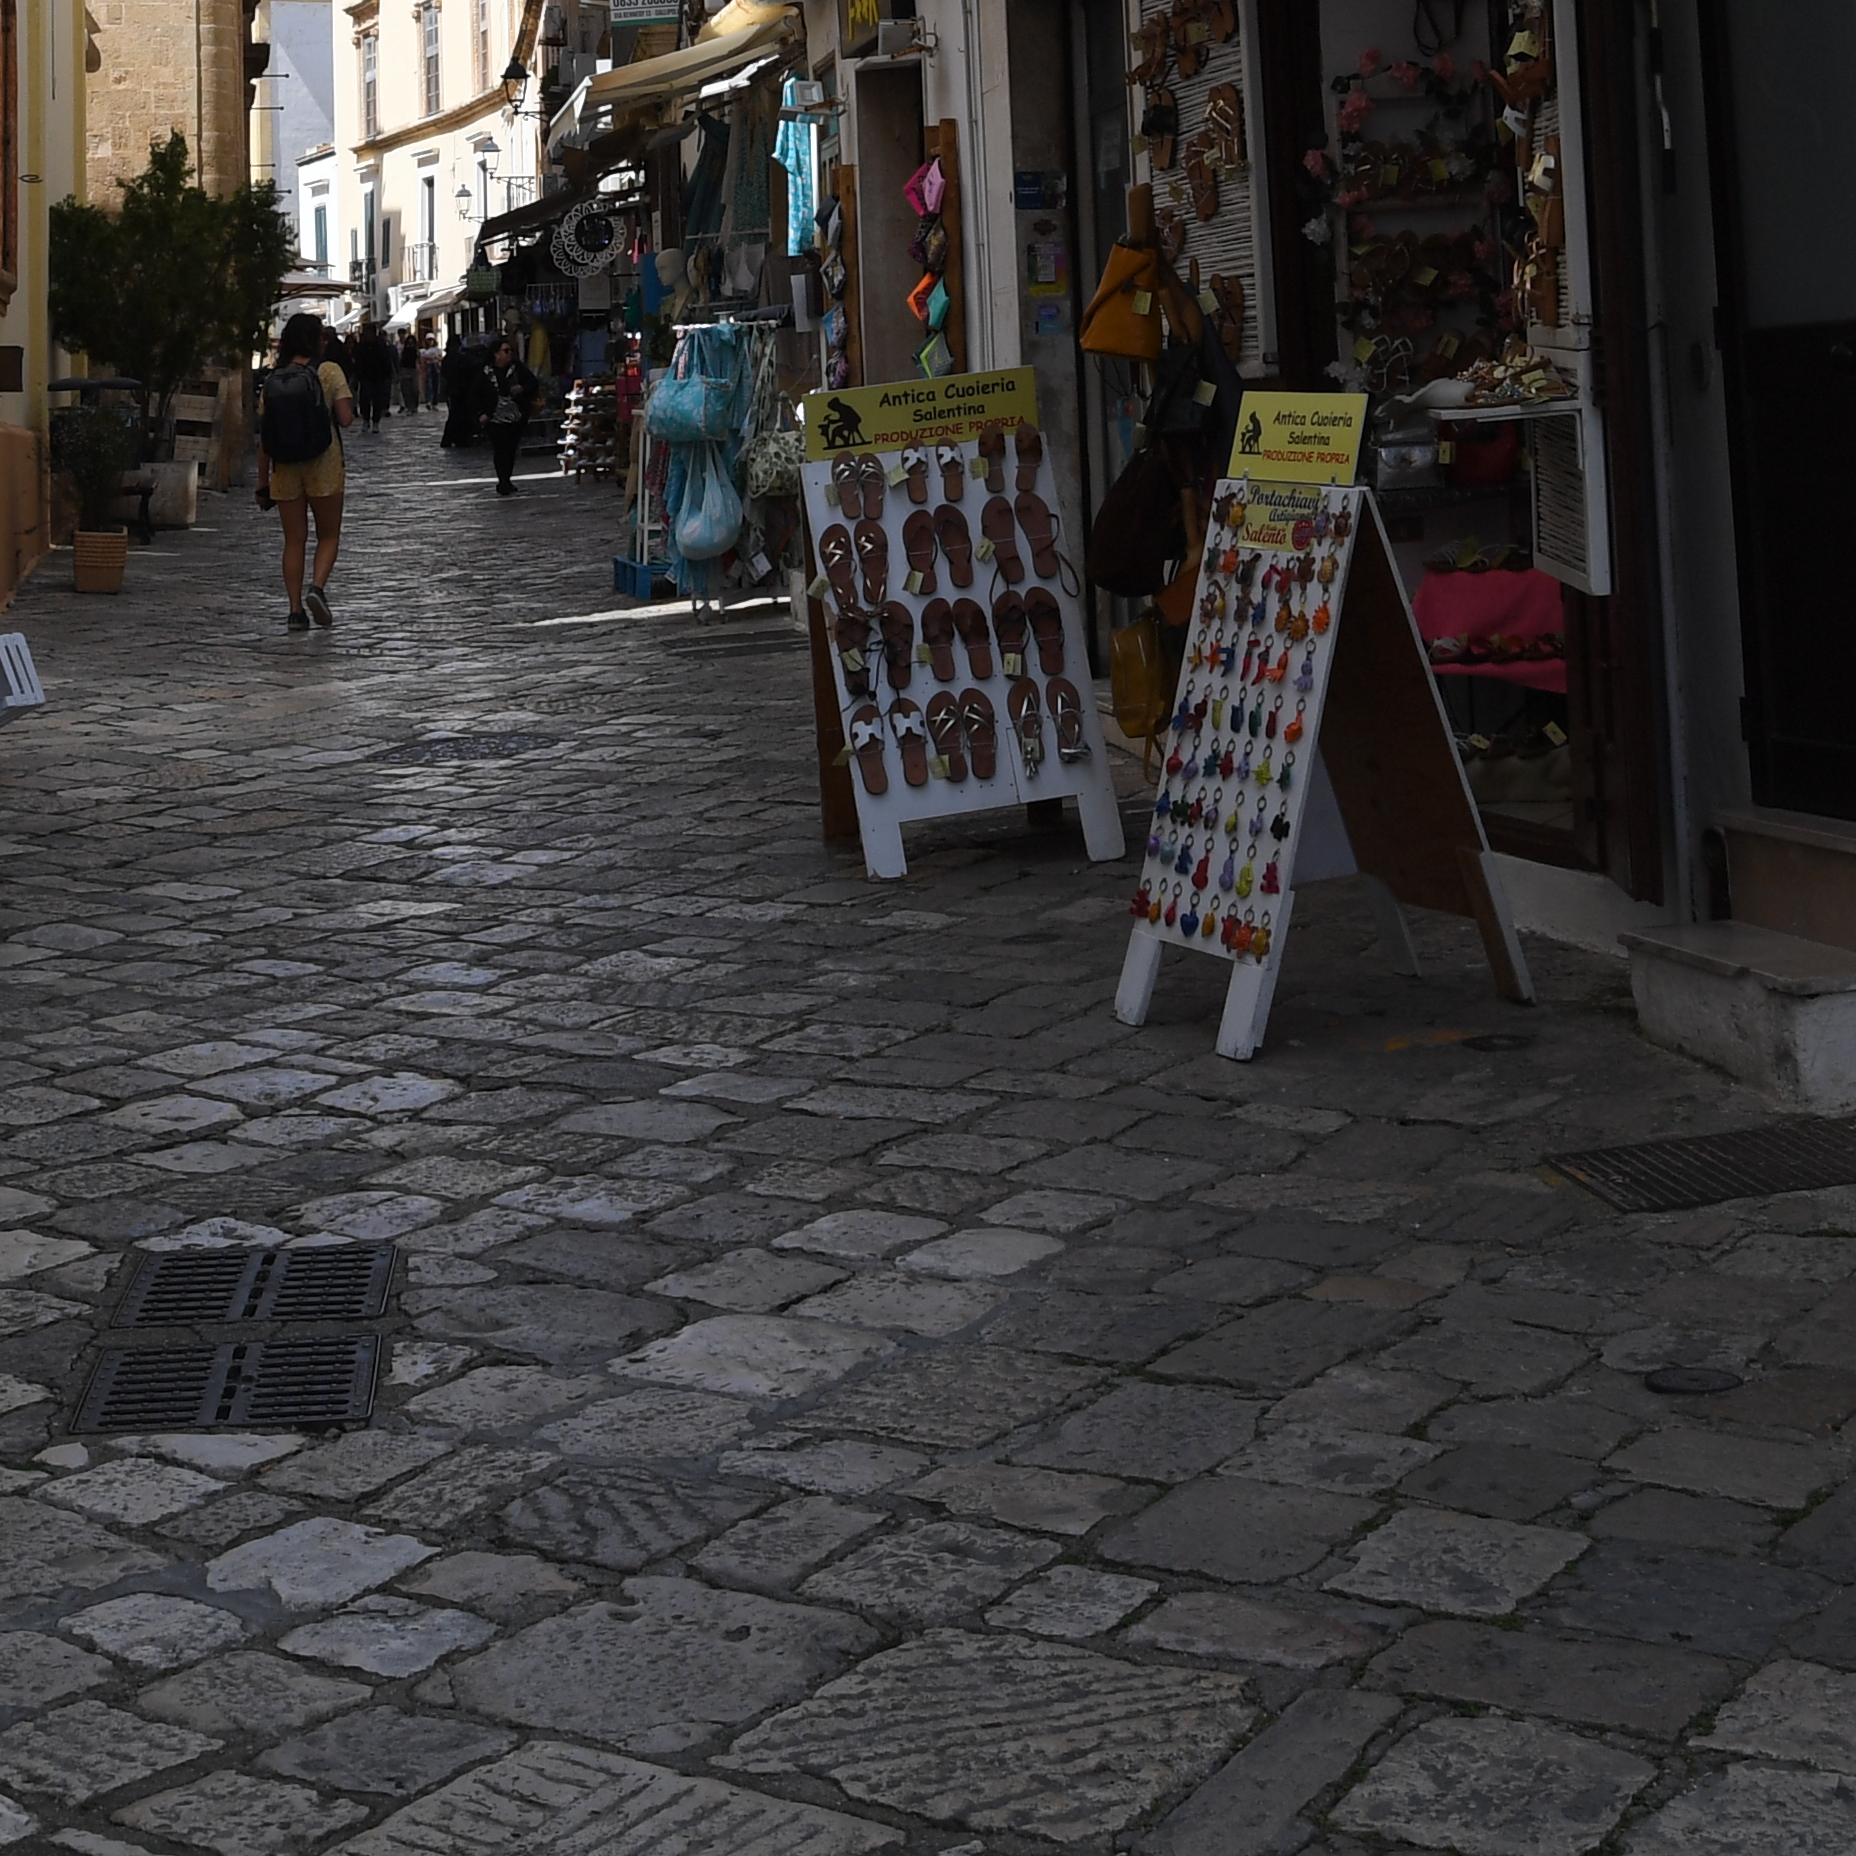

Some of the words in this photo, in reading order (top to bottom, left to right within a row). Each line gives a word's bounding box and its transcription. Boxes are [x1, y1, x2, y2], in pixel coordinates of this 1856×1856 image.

[879, 388, 937, 409] Antica
[944, 377, 1017, 400] Cuoieria
[912, 402, 987, 424] Salentina
[1272, 411, 1307, 426] Antica
[1310, 410, 1354, 429] Cuoieria
[874, 421, 964, 445] PRODUZIONE
[968, 415, 1027, 434] PROPRIA
[1287, 430, 1332, 447] Salentina
[1261, 449, 1316, 464] PRODUZIONE
[1316, 450, 1351, 466] PROPRIA
[1247, 484, 1321, 512] Portachiavi
[1242, 522, 1287, 546] Salento
